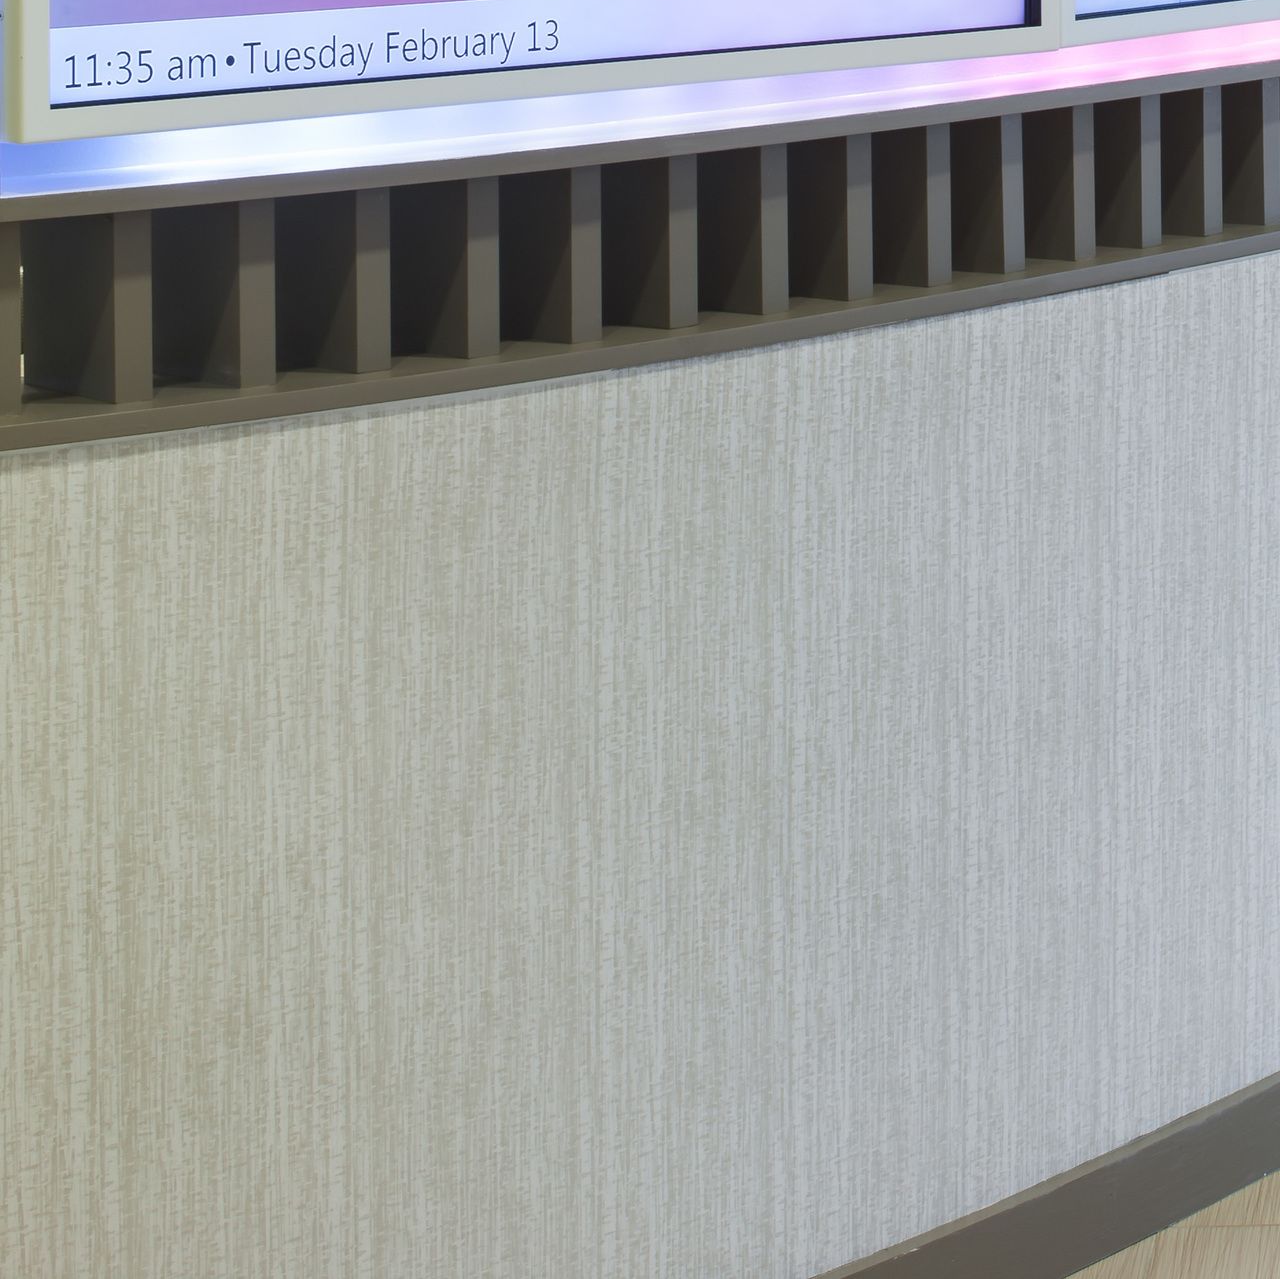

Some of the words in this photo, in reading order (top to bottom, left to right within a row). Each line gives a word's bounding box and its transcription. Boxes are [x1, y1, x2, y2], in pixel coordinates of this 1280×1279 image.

[64, 49, 154, 89] 11:35
[167, 54, 217, 81] am
[243, 35, 374, 77] Tuesday
[385, 29, 517, 64] February
[527, 19, 561, 53] 13
